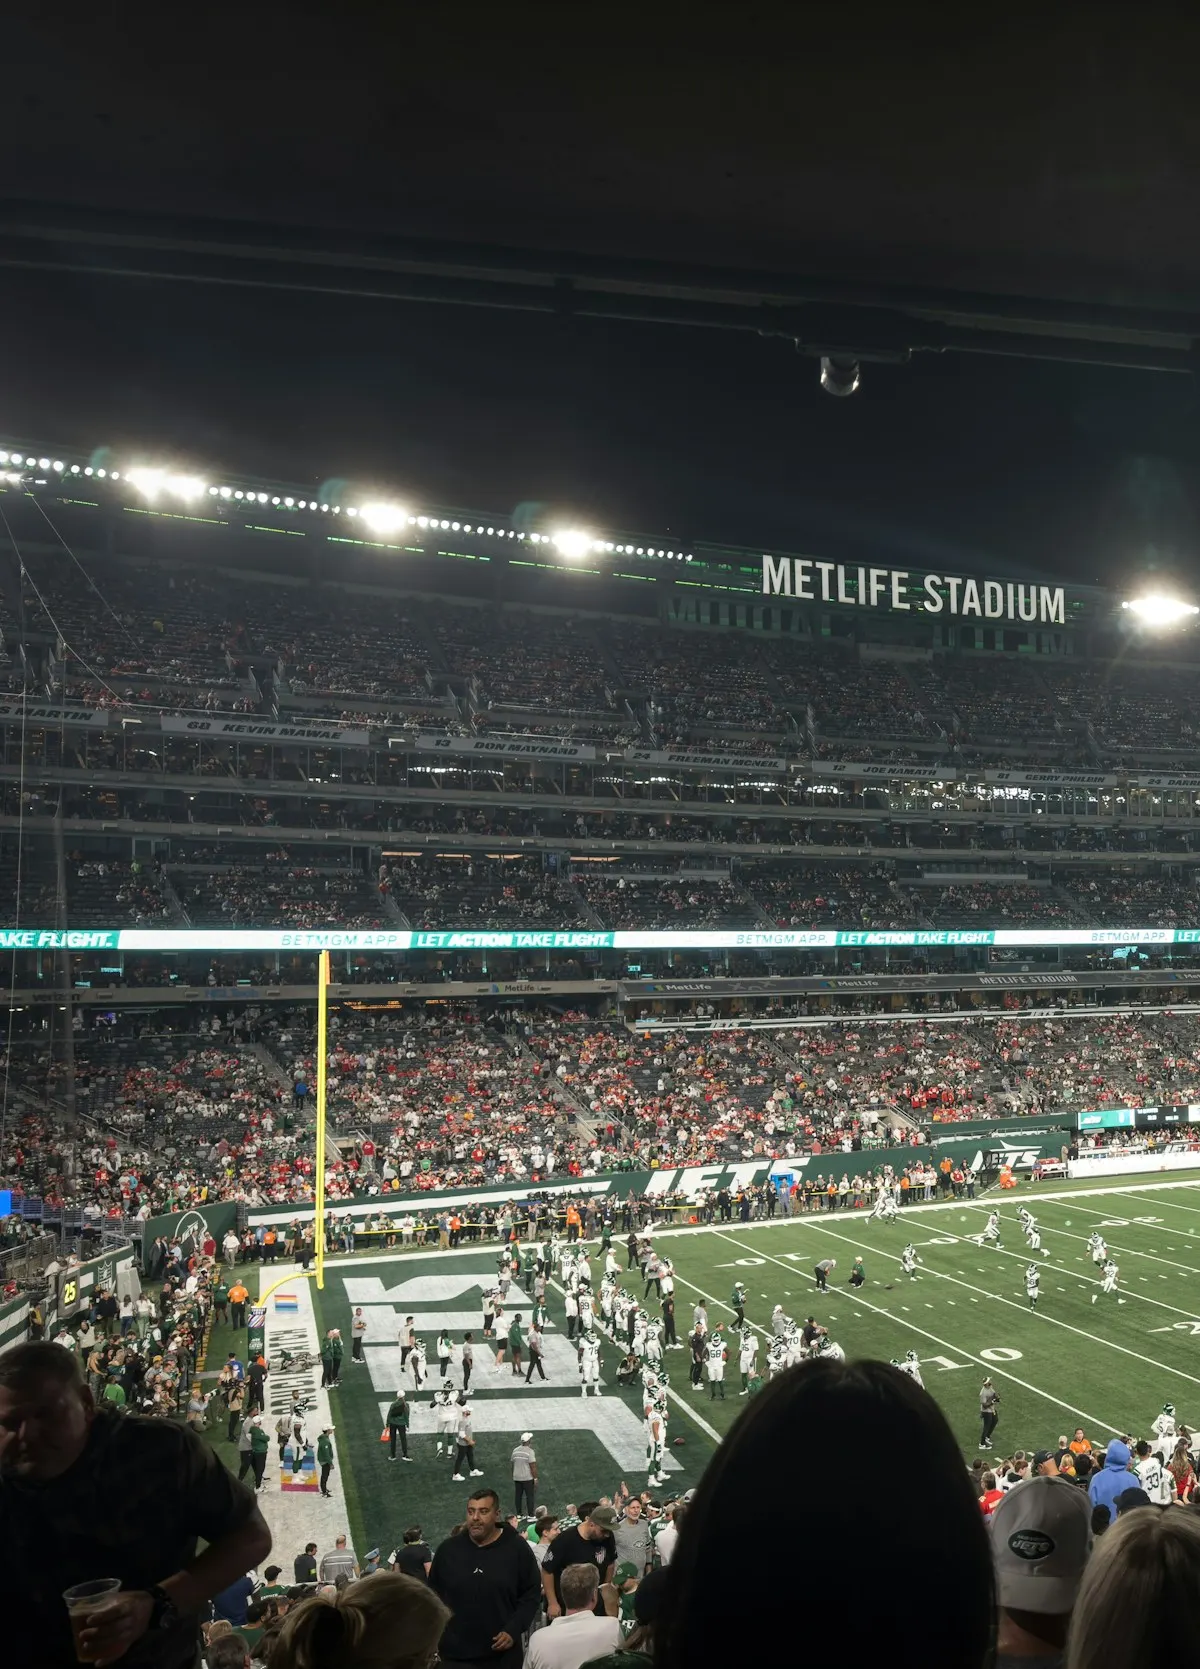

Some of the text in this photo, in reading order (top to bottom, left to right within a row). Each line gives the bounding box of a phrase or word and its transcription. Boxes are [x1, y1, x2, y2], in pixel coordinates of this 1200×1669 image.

[763, 554, 1065, 624] METLIFE STADIUM
[15, 707, 94, 721] MARTIN
[222, 723, 276, 735] KEVIN
[279, 727, 343, 740] MAWAE
[434, 739, 579, 756] 13 DON MAYNARD
[632, 752, 651, 760] 24
[667, 754, 729, 765] FREEMAN
[863, 766, 887, 774] JOE
[887, 767, 937, 776] NAMATH
[1025, 773, 1061, 782] GERRY
[38, 932, 113, 947] FLIGHT.
[281, 934, 358, 946] BETMGM
[417, 933, 610, 947] LET ACTION TAKE FLIGHT.
[736, 934, 795, 944] BETMGM
[841, 933, 992, 944] LET ACTION TAKE FLIGHT.
[1091, 932, 1140, 942] BETMGM
[1178, 931, 1200, 942] LET
[979, 975, 1078, 985] METLIFE STADIUM
[505, 984, 535, 992] MetLife
[665, 983, 712, 991] MetLife
[970, 1150, 1040, 1171] JETS
[64, 1282, 77, 1304] 25
[710, 1349, 722, 1359] 58
[920, 1347, 1023, 1371] 10
[1146, 1473, 1159, 1491] 33
